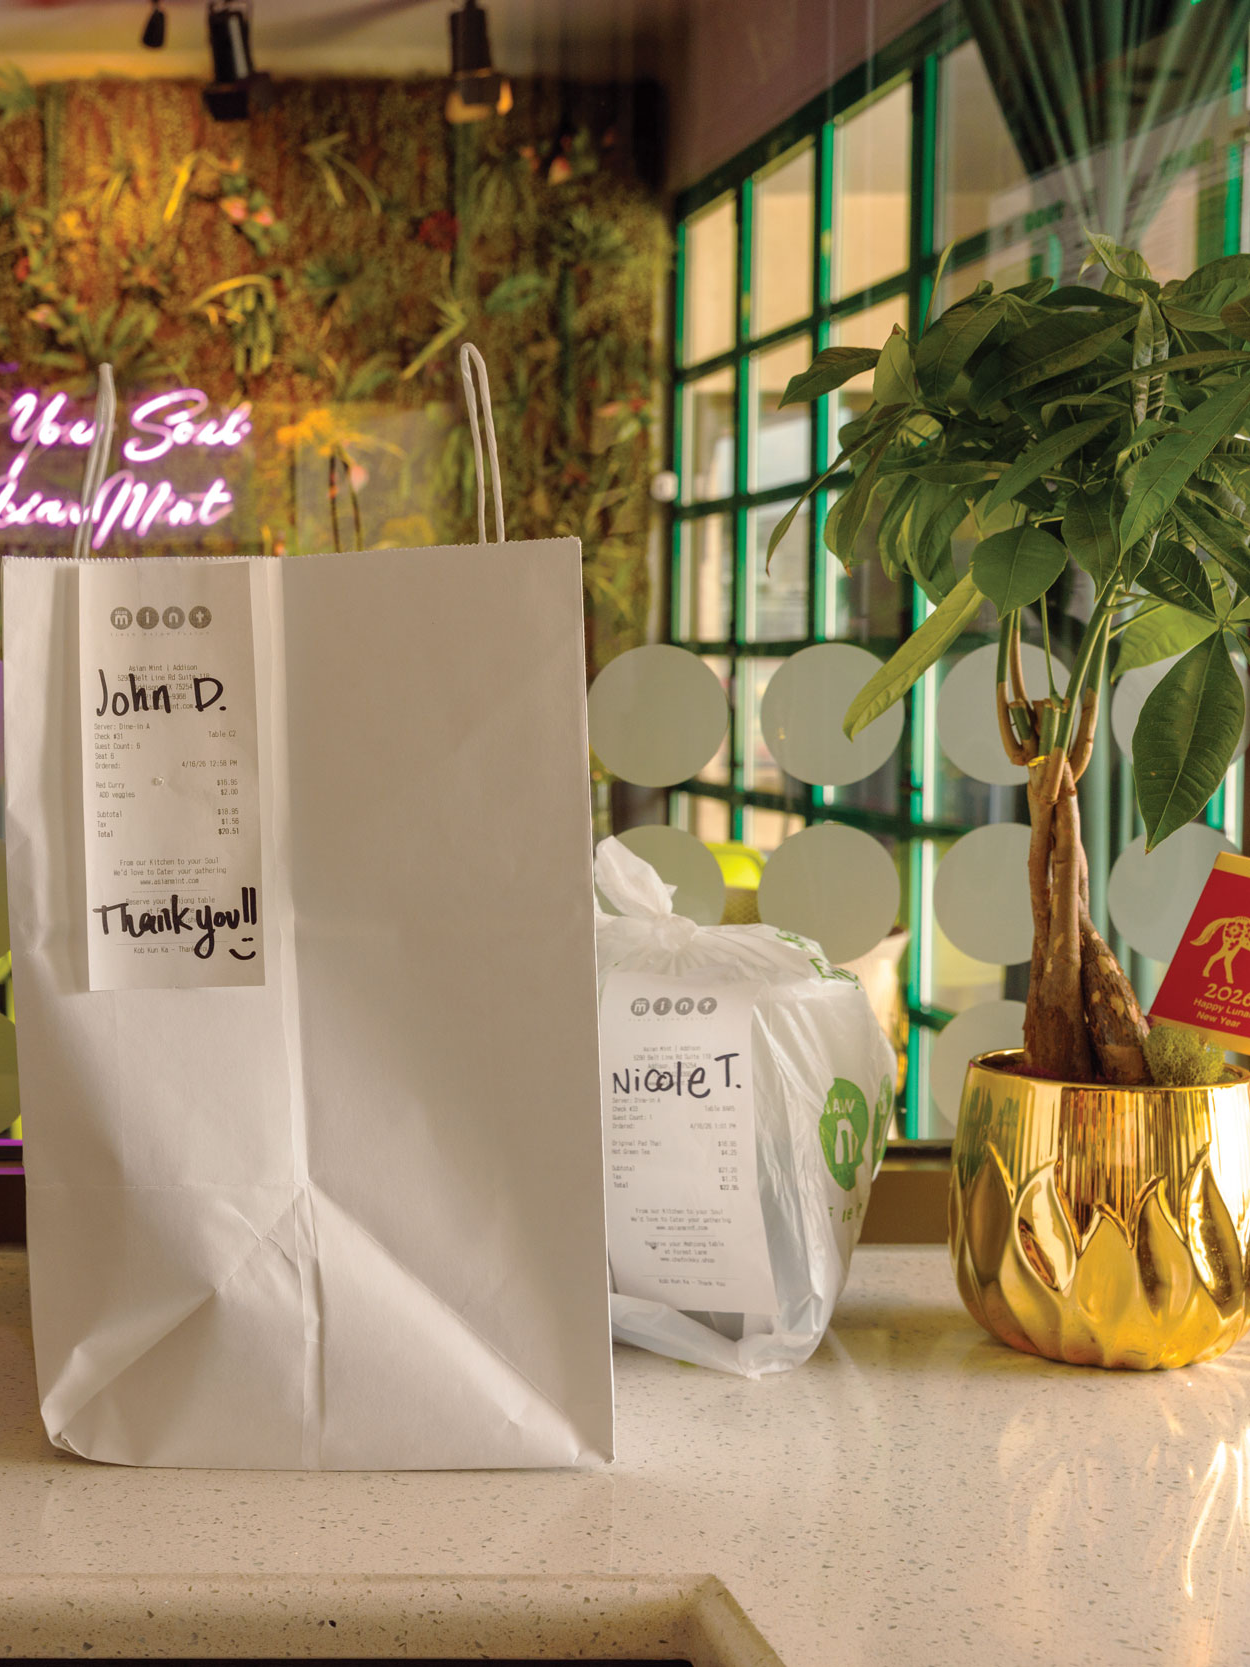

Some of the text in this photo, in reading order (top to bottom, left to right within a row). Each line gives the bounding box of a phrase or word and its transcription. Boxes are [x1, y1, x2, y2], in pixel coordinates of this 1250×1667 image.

[123, 389, 252, 462] Soul
[96, 668, 227, 717] John D.
[108, 782, 125, 790] Curry
[218, 828, 240, 836] $20.51
[92, 894, 193, 938] Thank
[1194, 998, 1250, 1018] Happy Luna
[1197, 1011, 1241, 1028] New Year
[612, 1052, 742, 1098] Nicole T.
